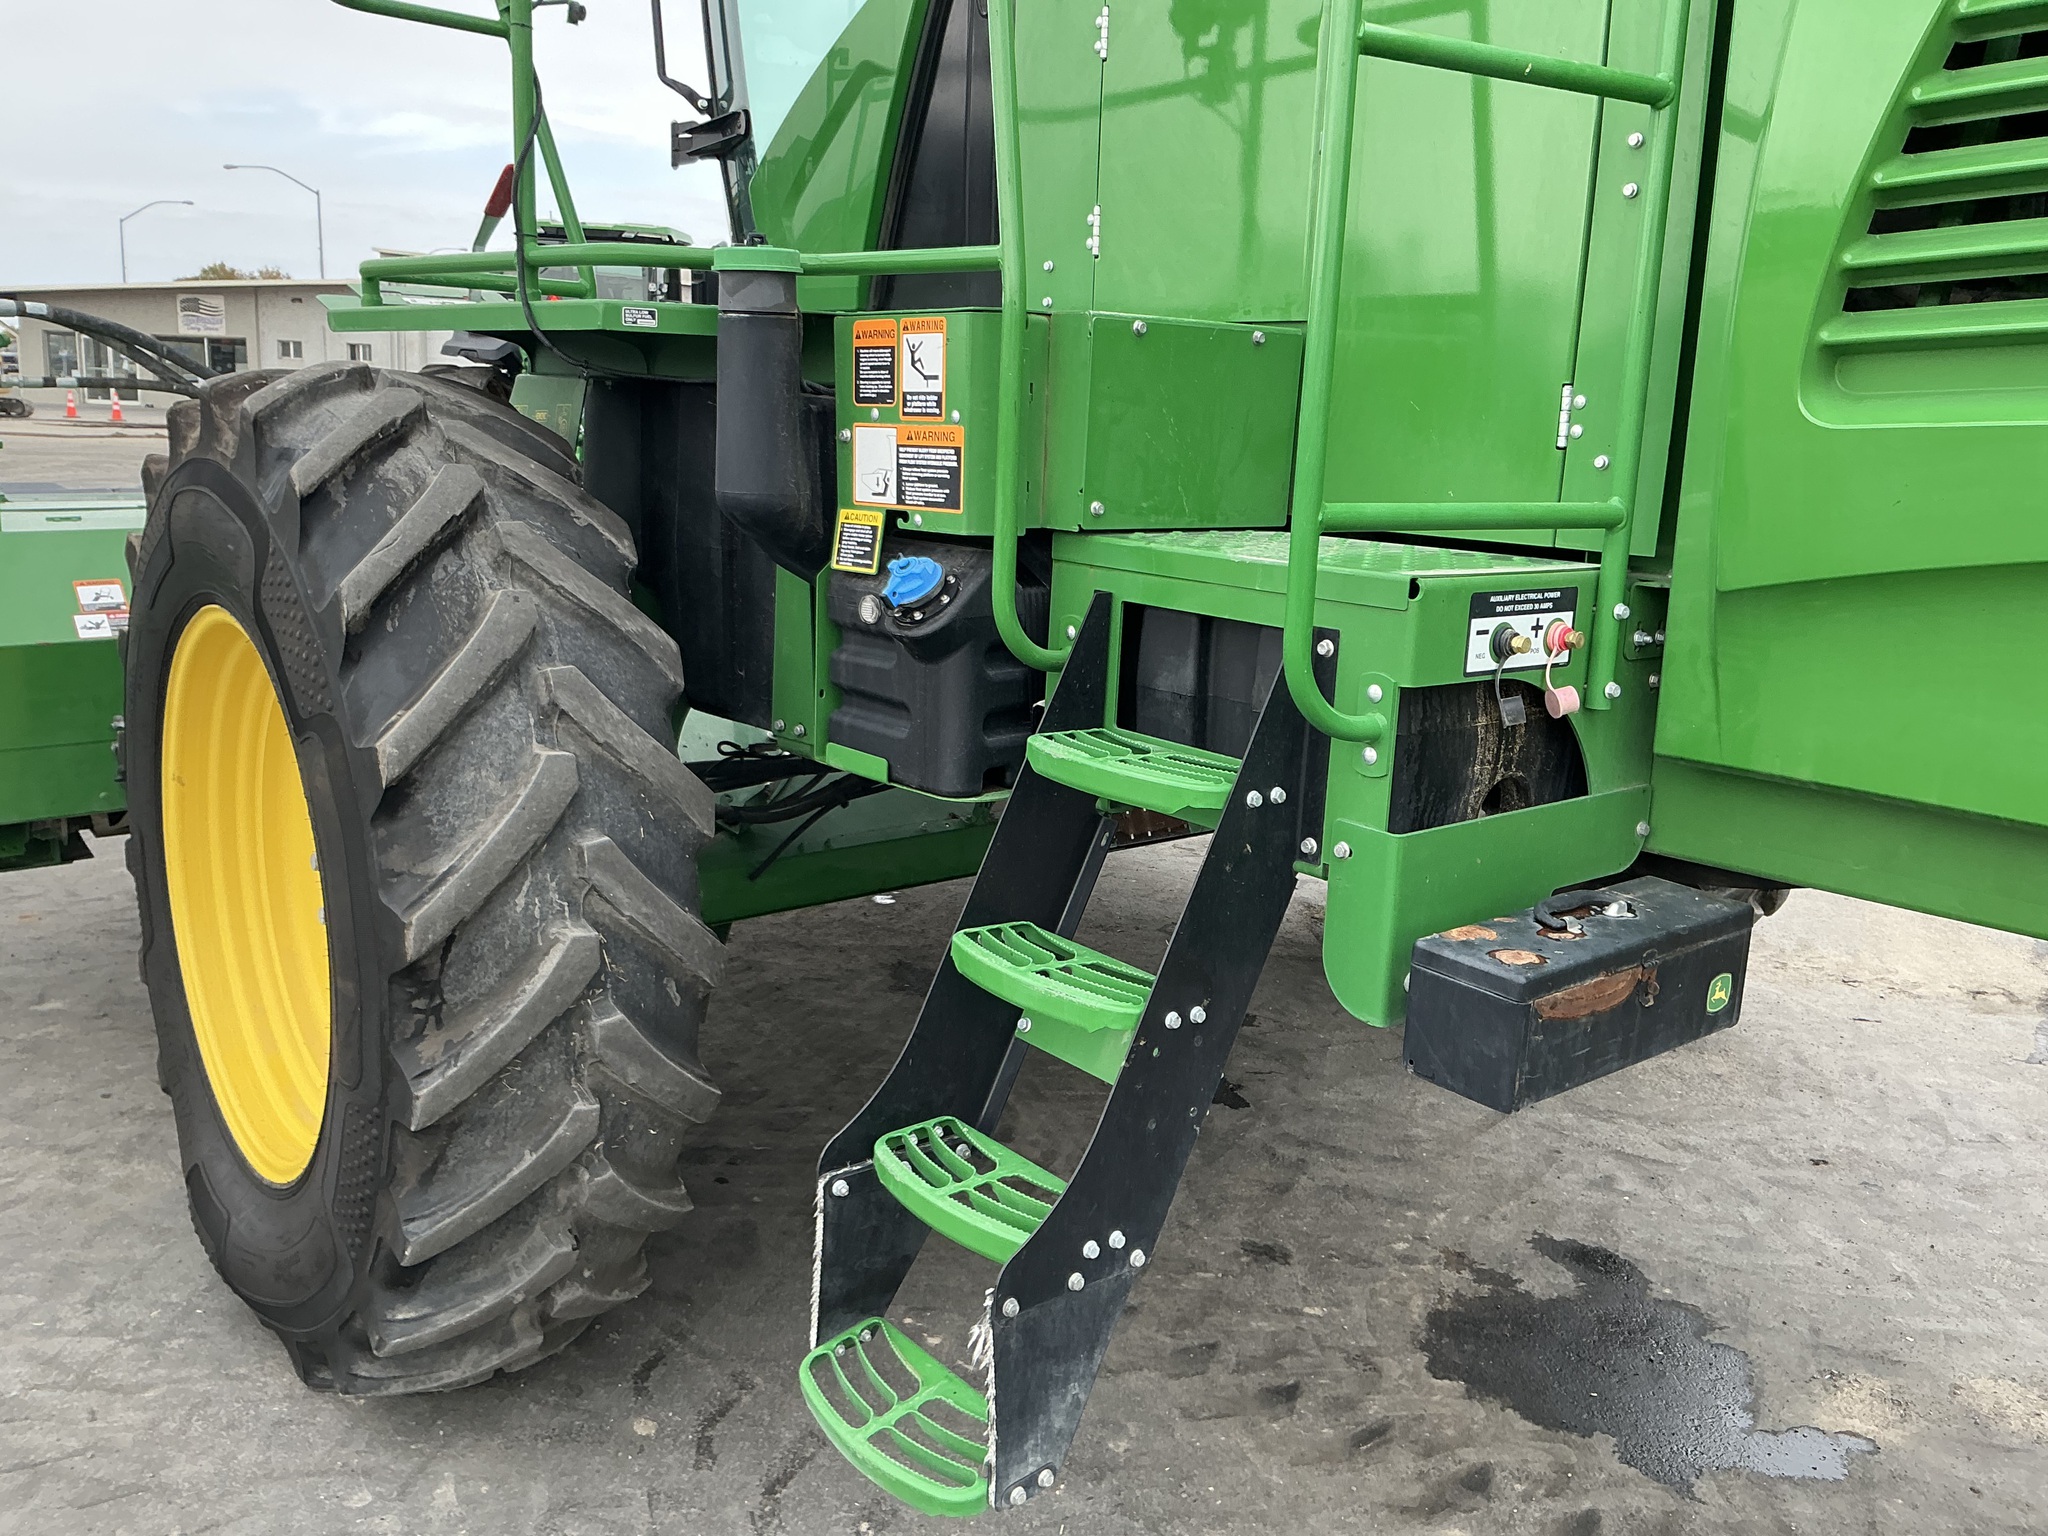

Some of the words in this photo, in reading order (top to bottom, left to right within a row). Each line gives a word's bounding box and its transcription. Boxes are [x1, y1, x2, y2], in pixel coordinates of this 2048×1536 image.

[910, 320, 944, 331] WARNING
[861, 329, 896, 339] WARNING
[913, 430, 956, 442] WARNING
[850, 513, 879, 523] CAUTION
[1489, 594, 1515, 603] AUXILIARY
[1515, 592, 1544, 601] ELECTRICAL
[1544, 591, 1561, 599] POWER
[1504, 604, 1515, 612] NOT
[1514, 603, 1533, 611] EXCEED
